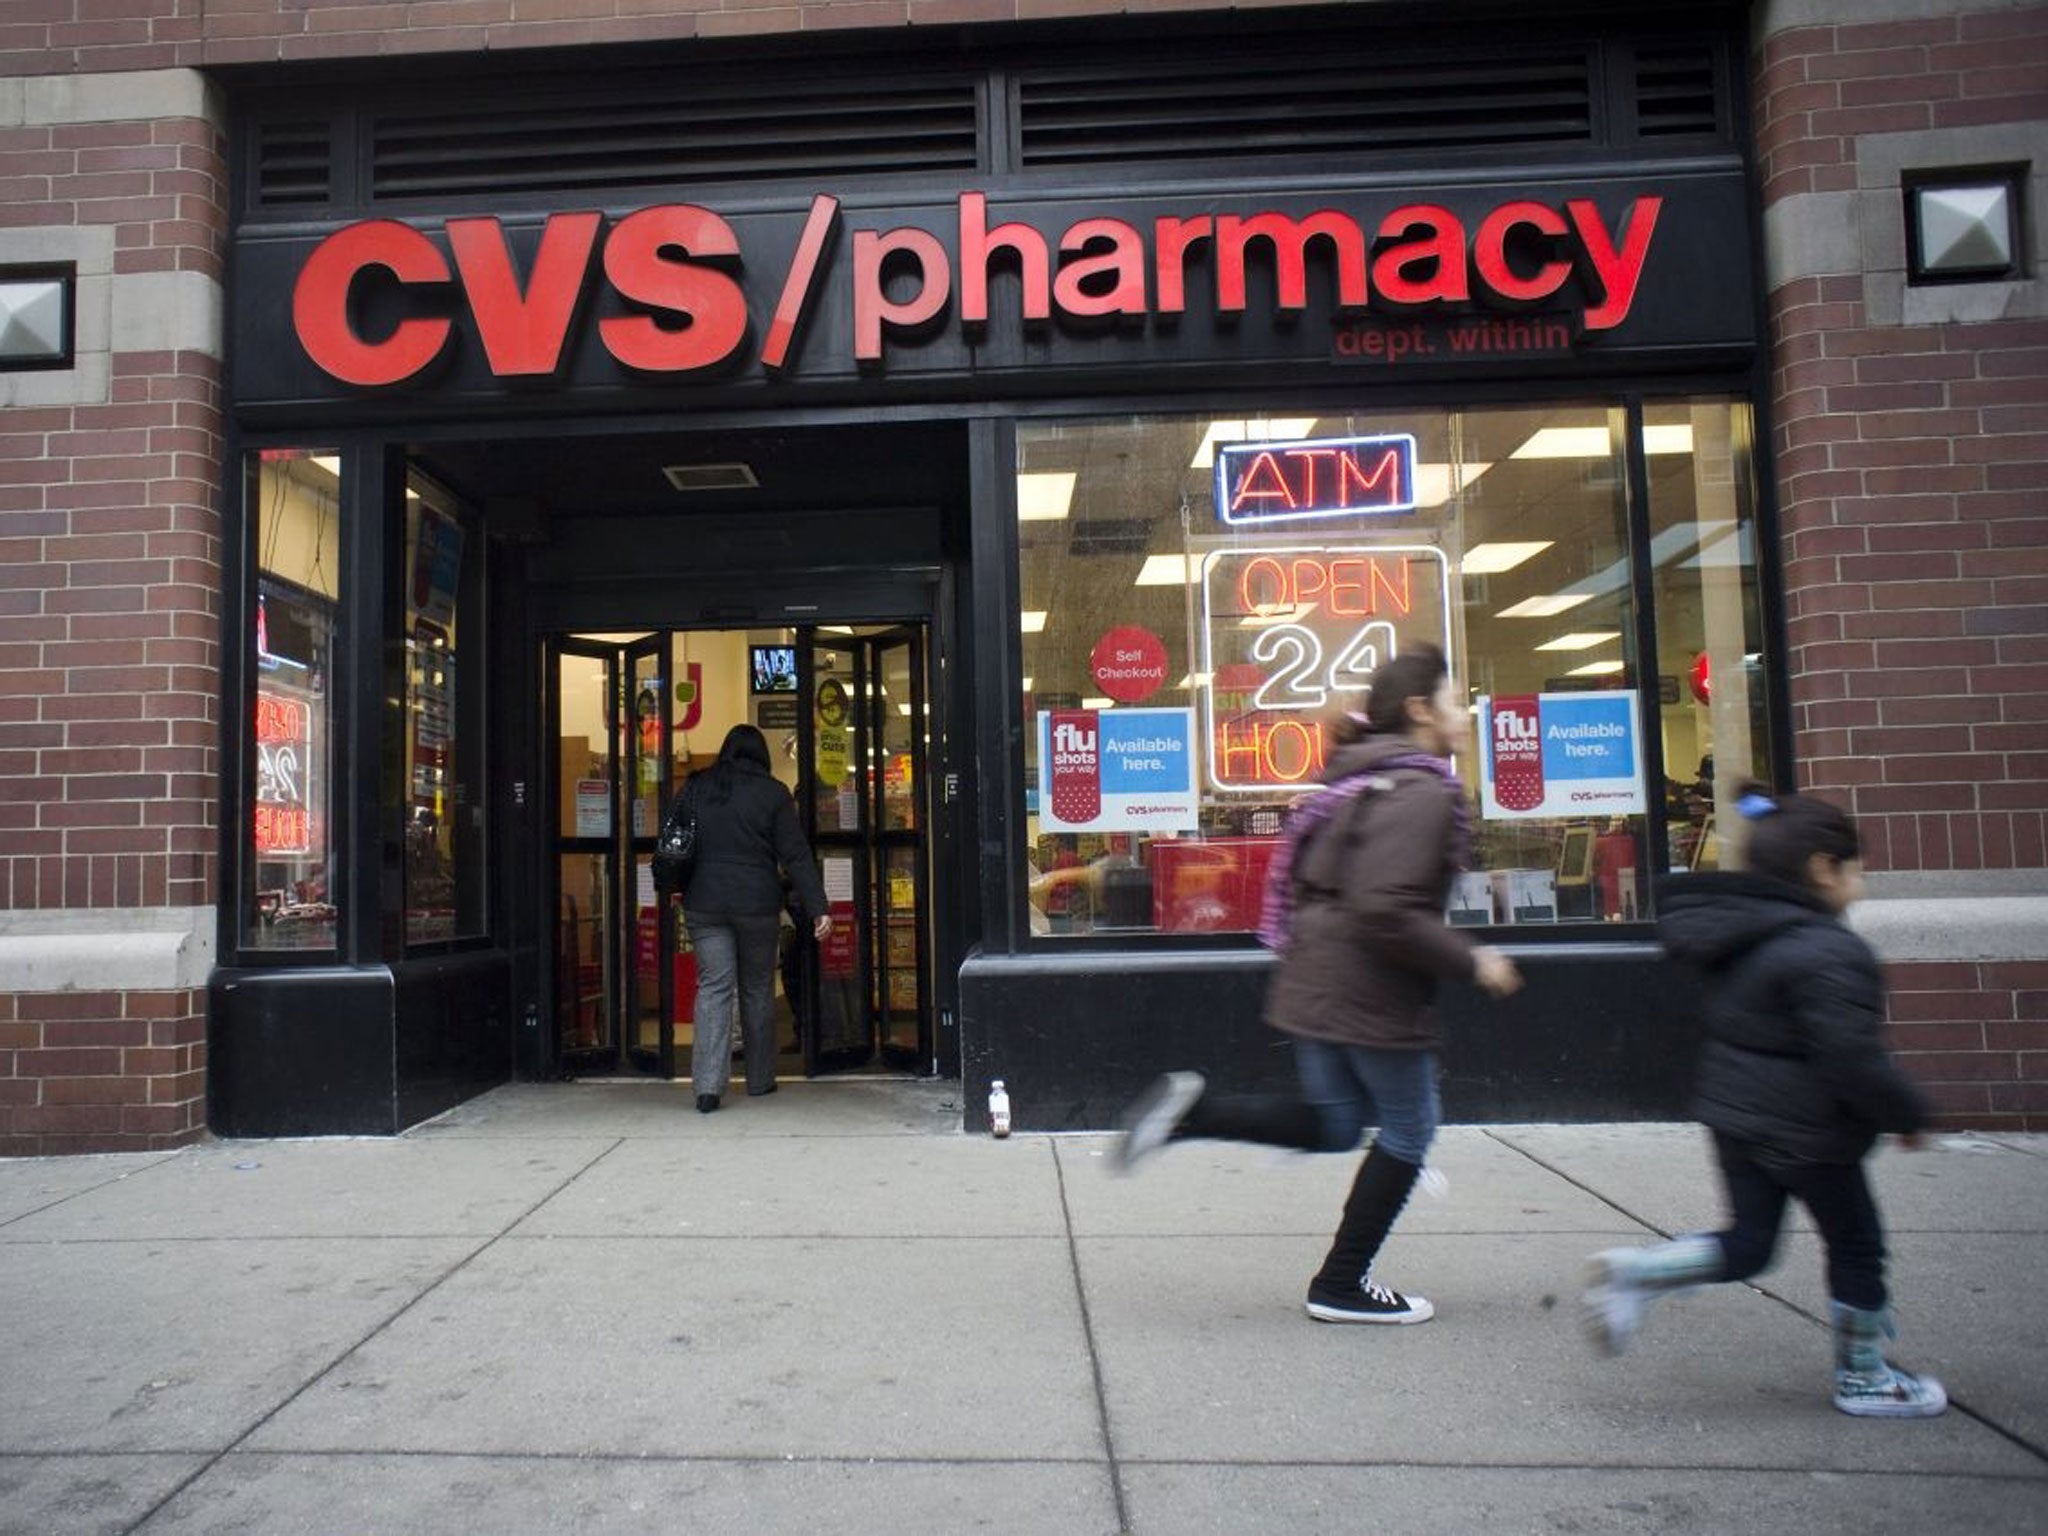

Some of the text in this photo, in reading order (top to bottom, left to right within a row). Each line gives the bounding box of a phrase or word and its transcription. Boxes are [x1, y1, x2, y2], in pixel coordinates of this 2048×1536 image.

[1335, 318, 1570, 361] dept. within
[1232, 449, 1398, 511] ATM
[1242, 557, 1410, 618] OPEN
[1115, 650, 1143, 662] Self
[1096, 666, 1164, 680] Checkout
[1252, 620, 1398, 711] 24
[1493, 710, 1538, 739] flu
[1546, 722, 1626, 740] Available
[1053, 722, 1097, 752] flu
[1105, 737, 1183, 754] Available
[1496, 738, 1539, 753] shots
[1564, 742, 1610, 758] here.
[1054, 751, 1097, 765] shots
[1122, 756, 1167, 771] here.
[1496, 751, 1539, 763] your way
[1054, 765, 1097, 776] your way
